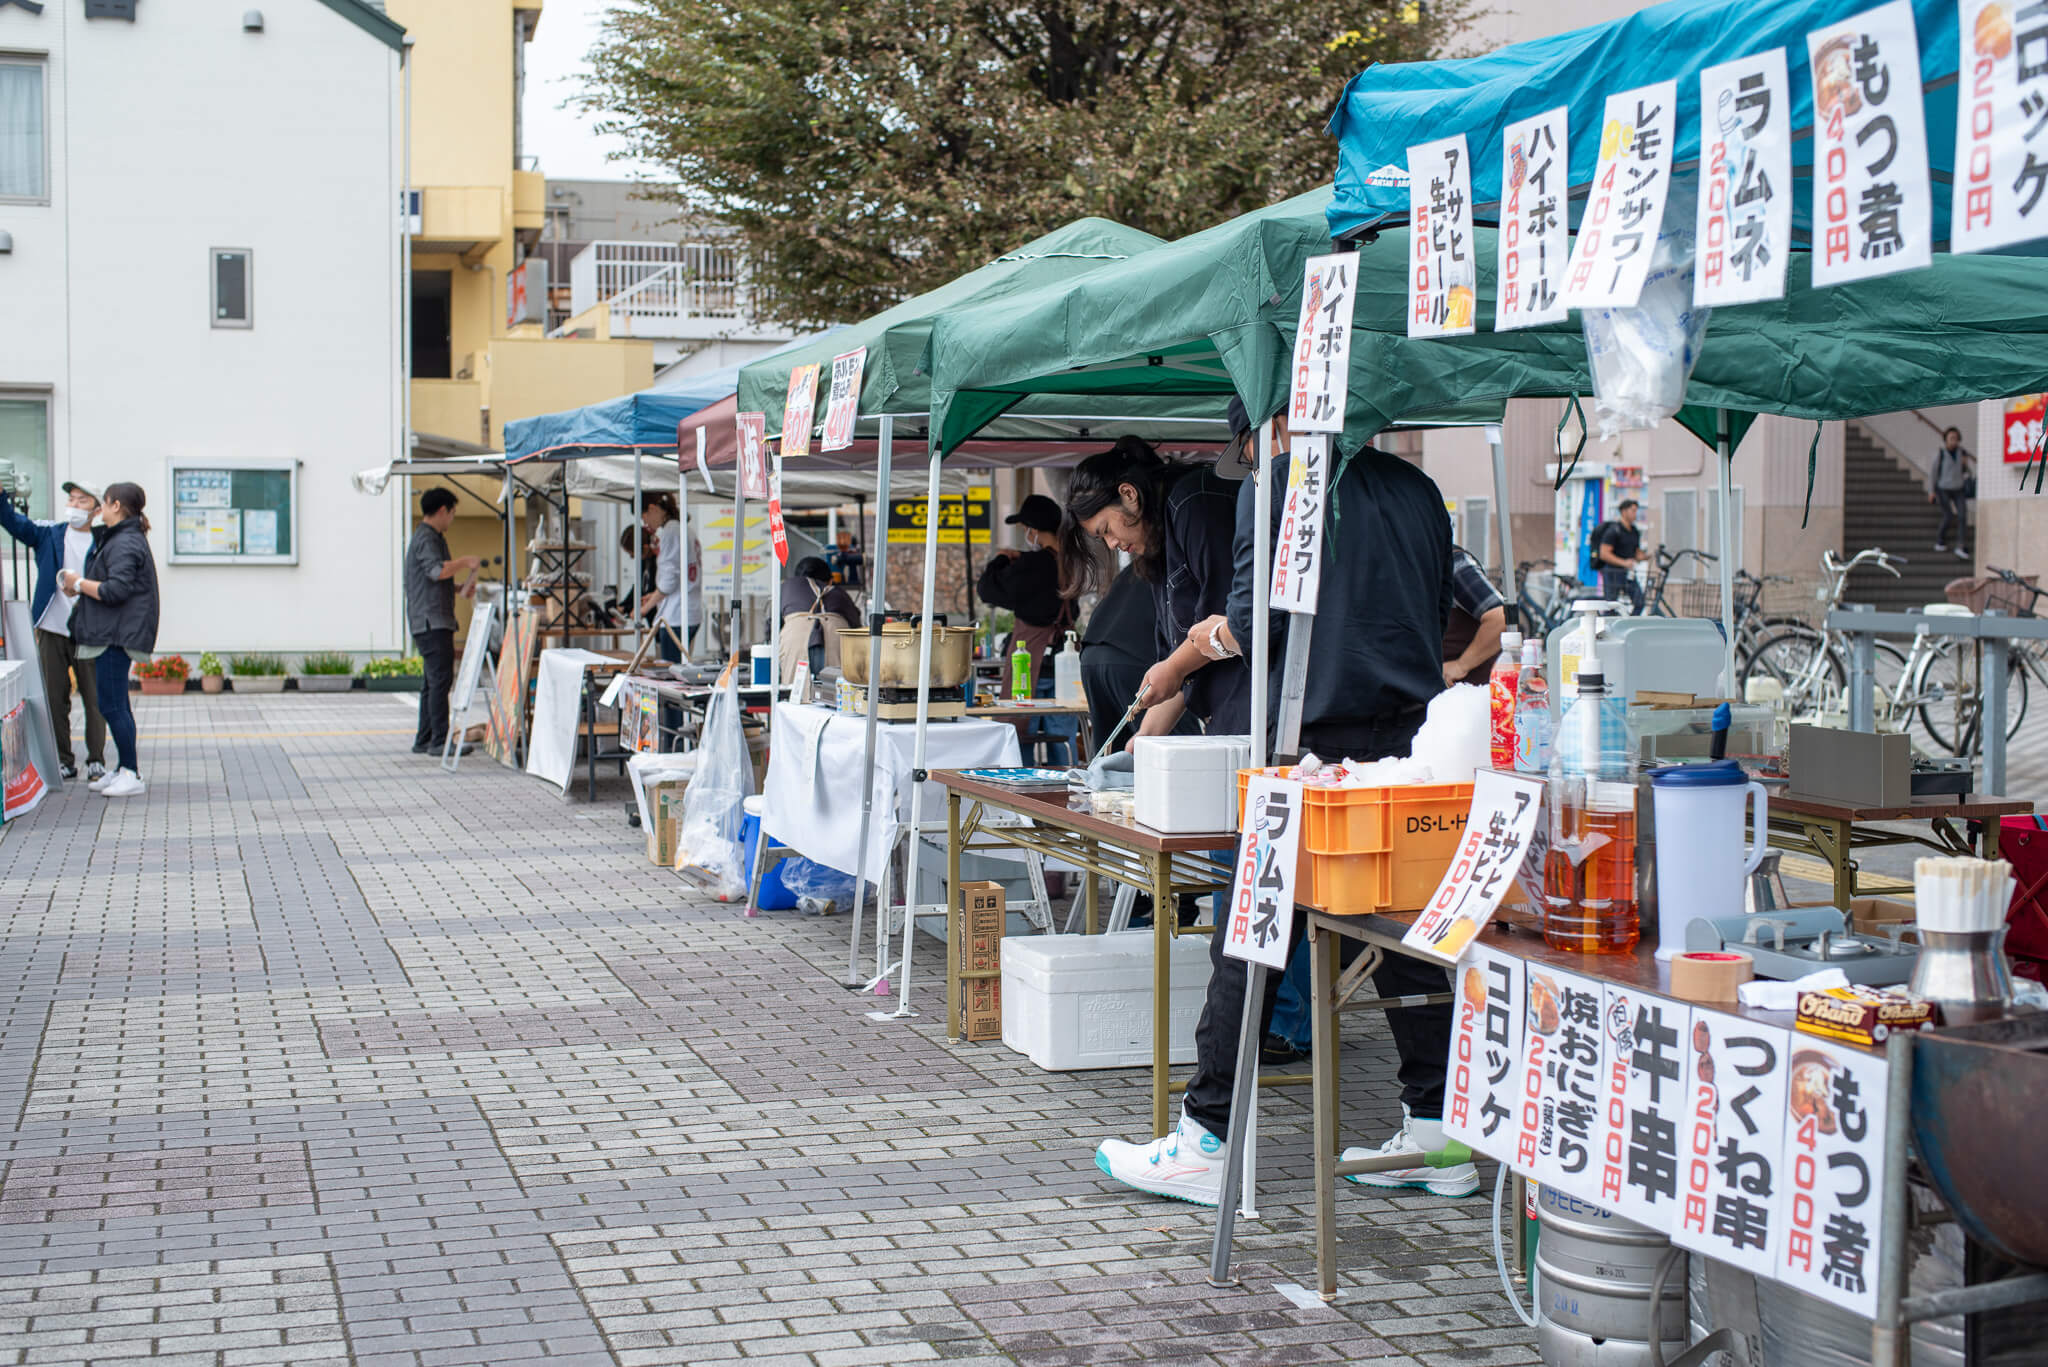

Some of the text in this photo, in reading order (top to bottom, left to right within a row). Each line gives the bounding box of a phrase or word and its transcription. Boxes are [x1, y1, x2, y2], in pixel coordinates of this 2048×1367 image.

[1730, 72, 1773, 281] ラムネ
[1826, 104, 1849, 266] 400円
[1854, 34, 1904, 260] もつ煮
[1967, 59, 1994, 231] 200円
[2013, 8, 2048, 217] ロッケ
[1416, 206, 1430, 324] 500円
[1504, 191, 1520, 314] 400円
[1526, 124, 1557, 312] ハイボール
[1568, 162, 1617, 293] 400円
[1608, 100, 1661, 294] レモンサワー
[1705, 141, 1727, 288] 200円
[1295, 312, 1314, 418] 400円
[1312, 265, 1348, 421] ハイボール
[1275, 491, 1297, 596] 400円
[1294, 446, 1321, 603] レモンサワー
[1233, 833, 1259, 944] 200円
[1252, 791, 1291, 949] ラムネ
[1416, 831, 1483, 936] 500円
[1451, 1003, 1474, 1129] 200円
[1480, 960, 1511, 1138] コロッケ
[1518, 1035, 1545, 1168] 200円
[1556, 987, 1599, 1174] 焼おにぎり
[1628, 1005, 1680, 1204] 牛串
[1602, 1062, 1627, 1201] 500円
[1684, 1085, 1714, 1234] 200円
[1712, 1036, 1777, 1251] つくね串
[1788, 1118, 1817, 1273] 400円
[1820, 1067, 1871, 1294] もつ煮
